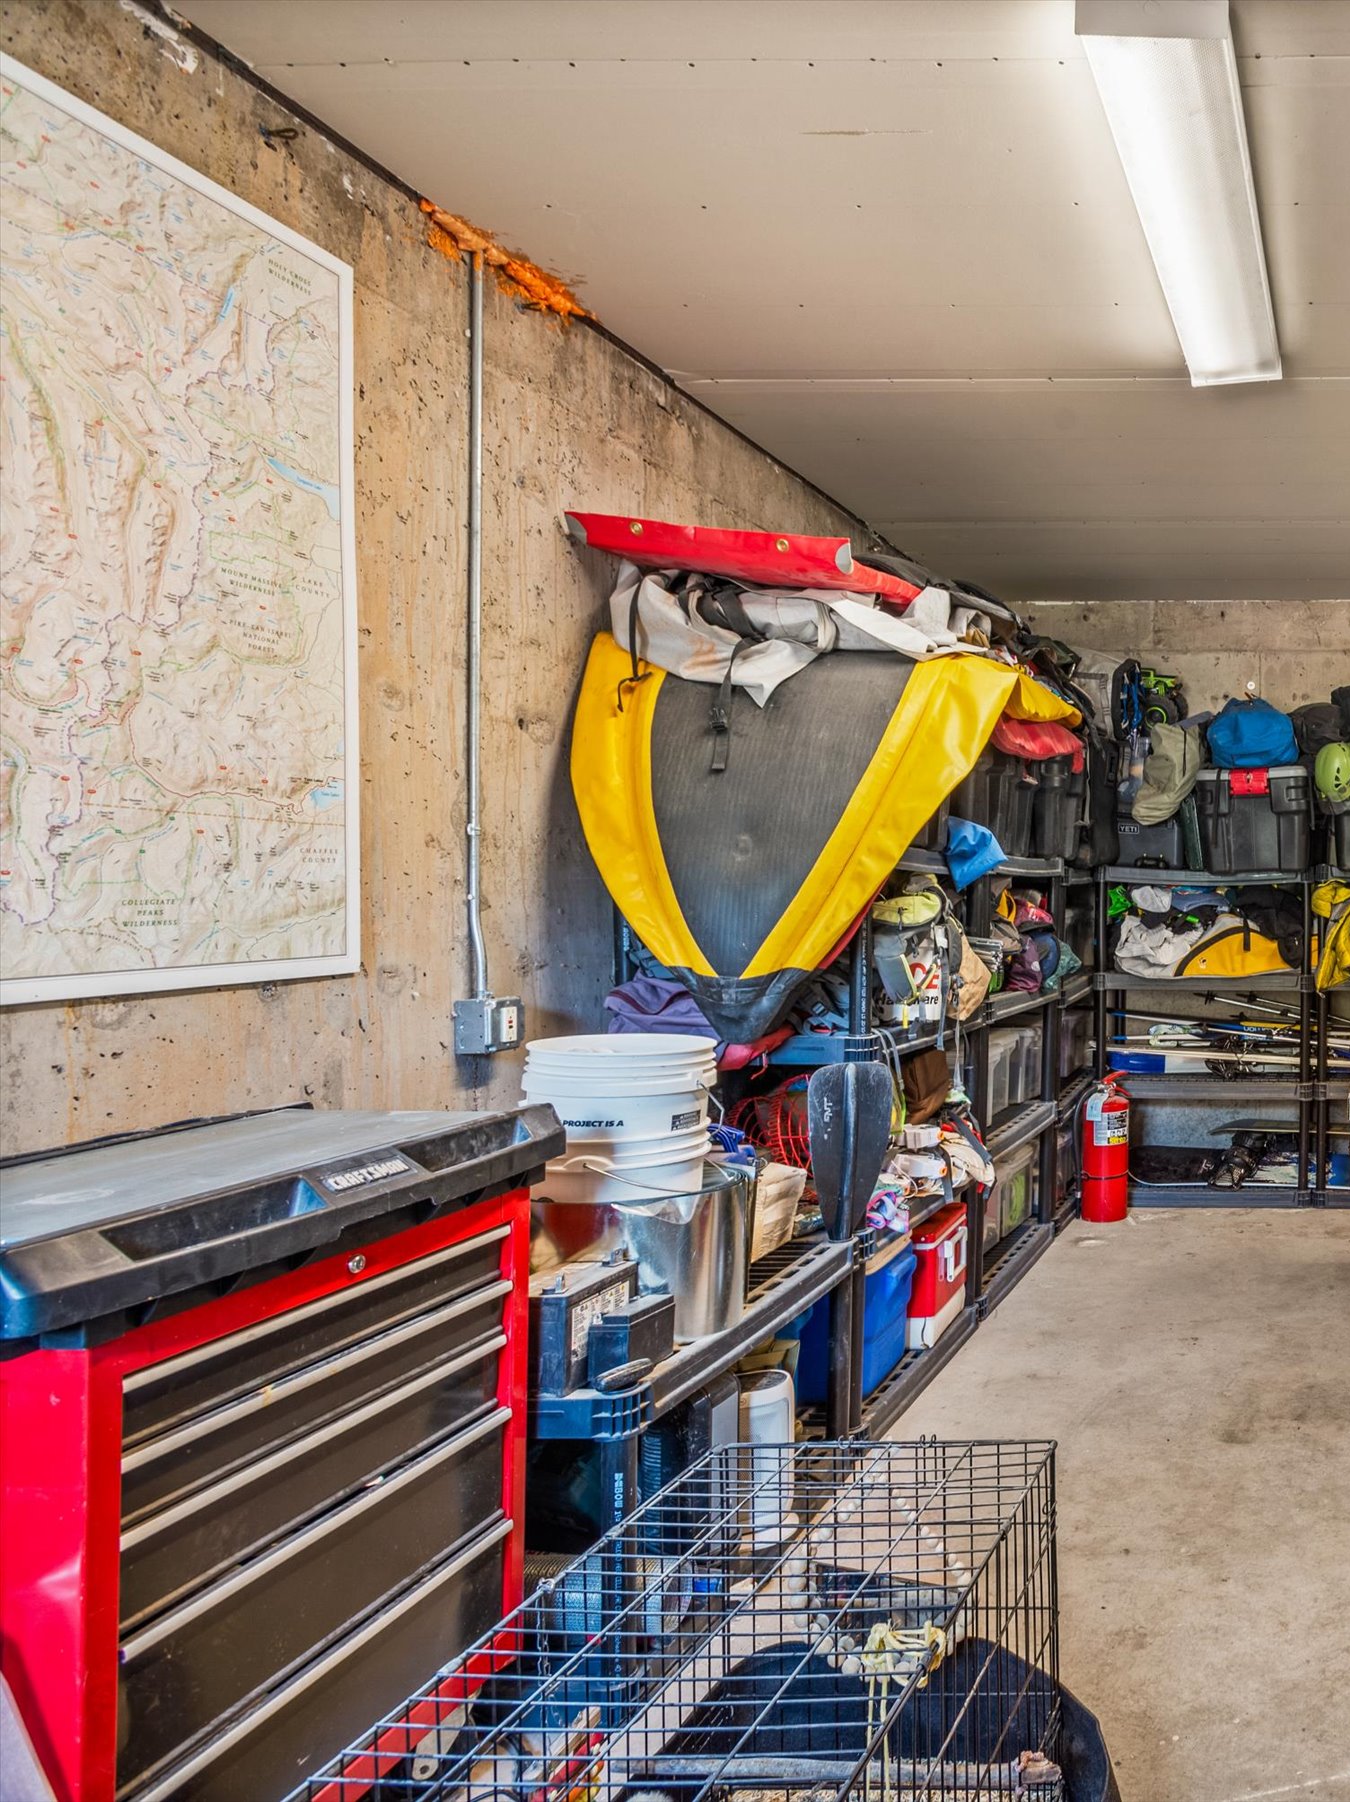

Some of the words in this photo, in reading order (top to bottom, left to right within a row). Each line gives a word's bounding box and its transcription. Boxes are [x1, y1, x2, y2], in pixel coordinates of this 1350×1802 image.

[220, 567, 249, 580] MOUNT
[229, 579, 275, 597] WILDERNESS
[302, 576, 324, 588] LAKE
[295, 584, 330, 598] COUNTY
[243, 632, 280, 646] NATIONAL
[248, 643, 275, 654] FOREST
[121, 898, 176, 906] COLLEGIATE
[122, 920, 178, 928] WILDERNESS
[562, 1120, 602, 1128] PROJECT
[322, 1158, 411, 1192] CRAFTSMAN
